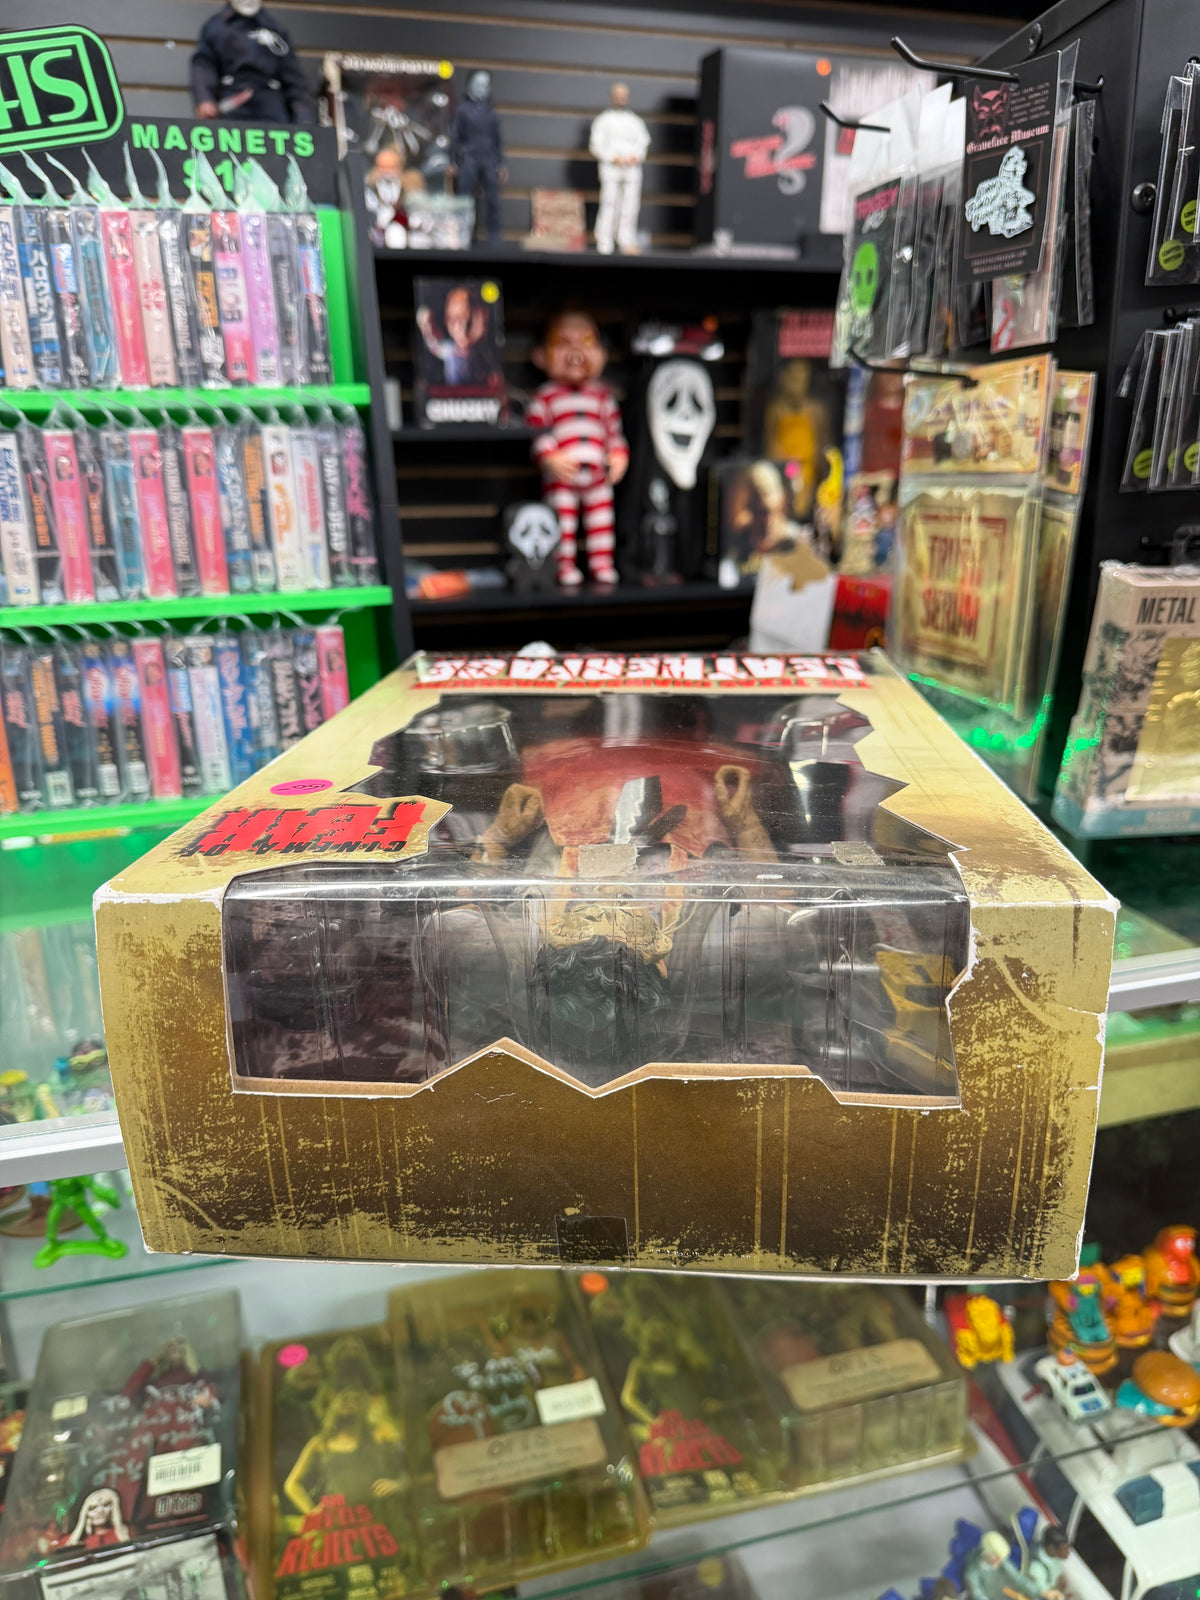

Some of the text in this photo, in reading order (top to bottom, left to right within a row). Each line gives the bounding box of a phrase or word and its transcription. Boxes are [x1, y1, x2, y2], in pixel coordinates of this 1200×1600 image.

[0, 48, 88, 129] HS
[131, 123, 315, 157] MAGNETS
[966, 124, 1050, 155] Graveface Museum
[322, 454, 340, 484] DAY
[327, 511, 346, 551] DEAD
[1136, 597, 1195, 626] METAL
[427, 656, 867, 682] LEATHERFACE
[718, 679, 809, 689] TEXAS
[196, 801, 428, 854] FEAR
[176, 840, 407, 858] CINEMA OF
